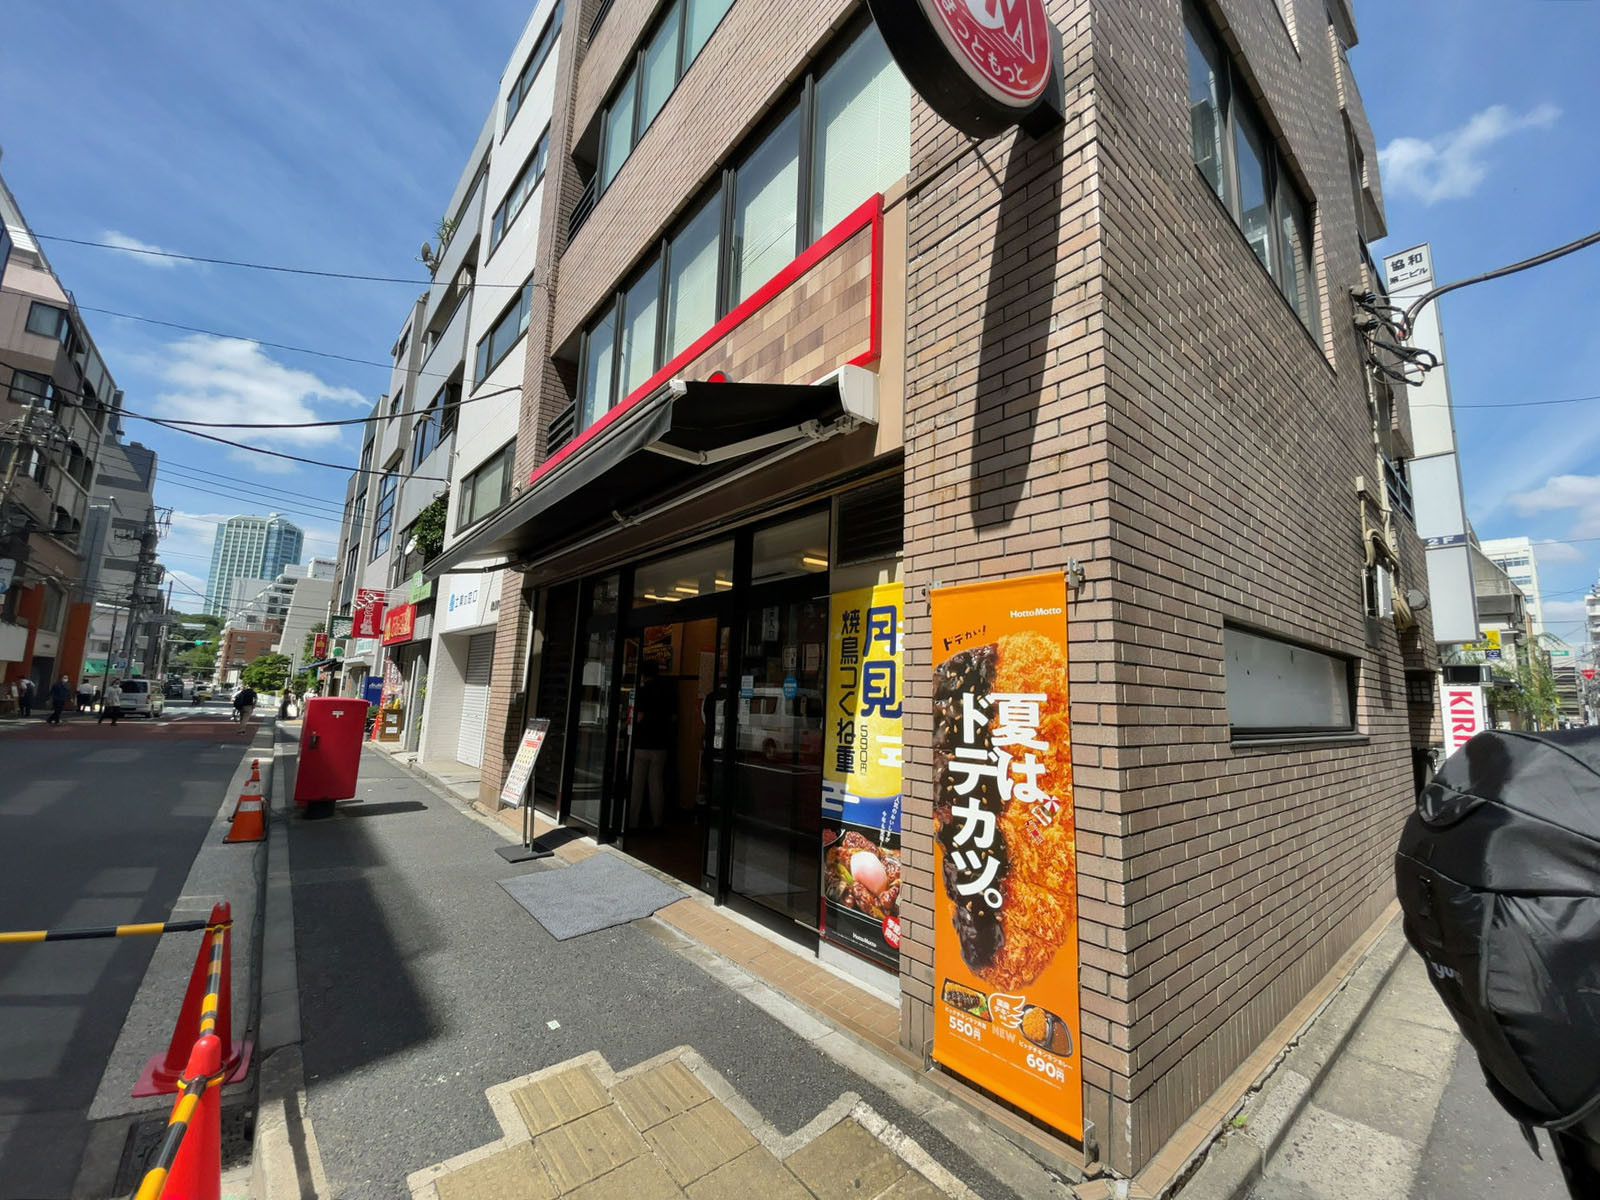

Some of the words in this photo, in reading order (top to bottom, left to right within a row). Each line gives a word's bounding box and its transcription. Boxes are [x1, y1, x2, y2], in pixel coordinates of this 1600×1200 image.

[1391, 253, 1422, 271] 協和
[1427, 536, 1455, 546] 2F
[1010, 607, 1062, 618] HottoMotto
[860, 605, 902, 718] 月見
[835, 609, 861, 774] 焼鳥つくね重
[1449, 691, 1476, 747] KIRI
[991, 692, 1049, 803] 夏は
[948, 692, 1003, 908] ドデカツ。
[949, 1016, 981, 1041] 550円
[991, 1025, 1016, 1043] NEW
[1026, 1054, 1065, 1083] 690円
